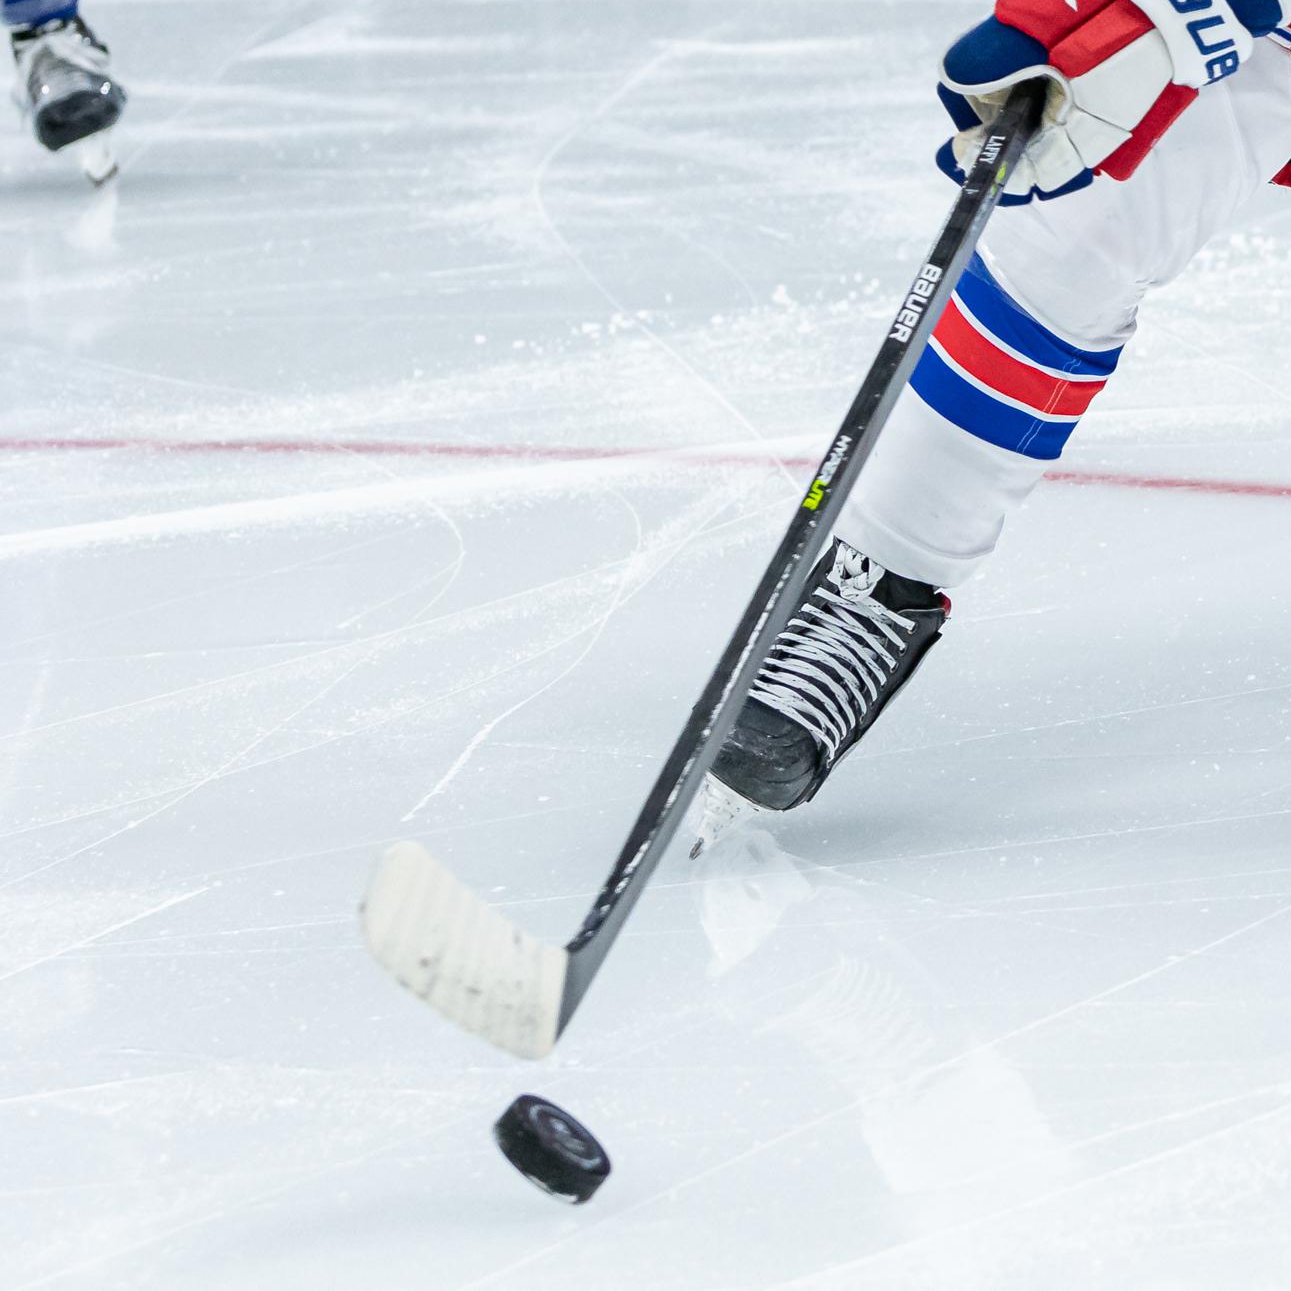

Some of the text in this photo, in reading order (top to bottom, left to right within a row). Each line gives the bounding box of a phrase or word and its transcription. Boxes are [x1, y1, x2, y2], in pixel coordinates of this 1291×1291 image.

[978, 135, 1006, 165] LAFFY
[889, 262, 942, 344] BAUER
[802, 434, 852, 511] HYPERLITE
